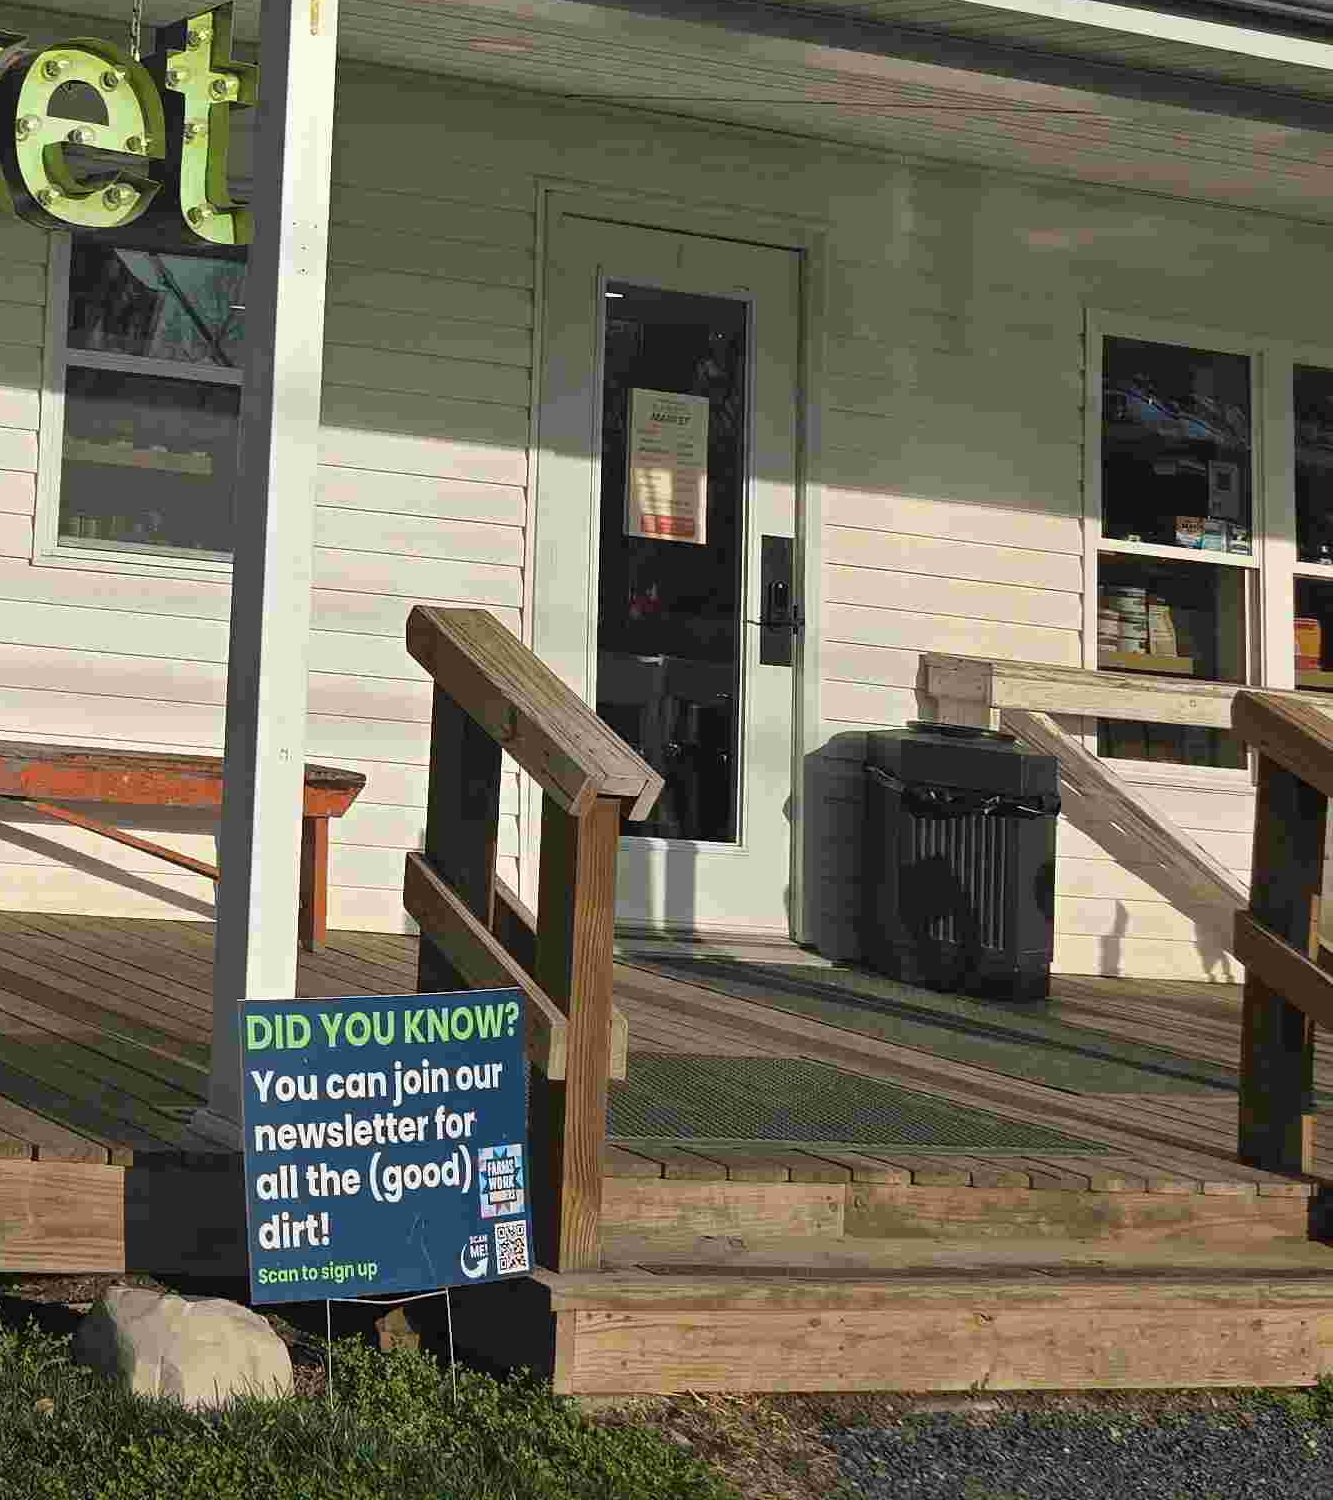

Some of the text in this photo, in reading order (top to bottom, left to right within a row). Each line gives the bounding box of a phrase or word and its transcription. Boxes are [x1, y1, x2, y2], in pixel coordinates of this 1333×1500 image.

[245, 1002, 520, 1051] DID YOU KNOW?
[251, 1058, 503, 1106] You can join our
[254, 1105, 477, 1152] newsletter for
[256, 1144, 473, 1203] all the (good)
[258, 1211, 331, 1250] dirt!
[258, 1260, 378, 1285] Scan to sign up
